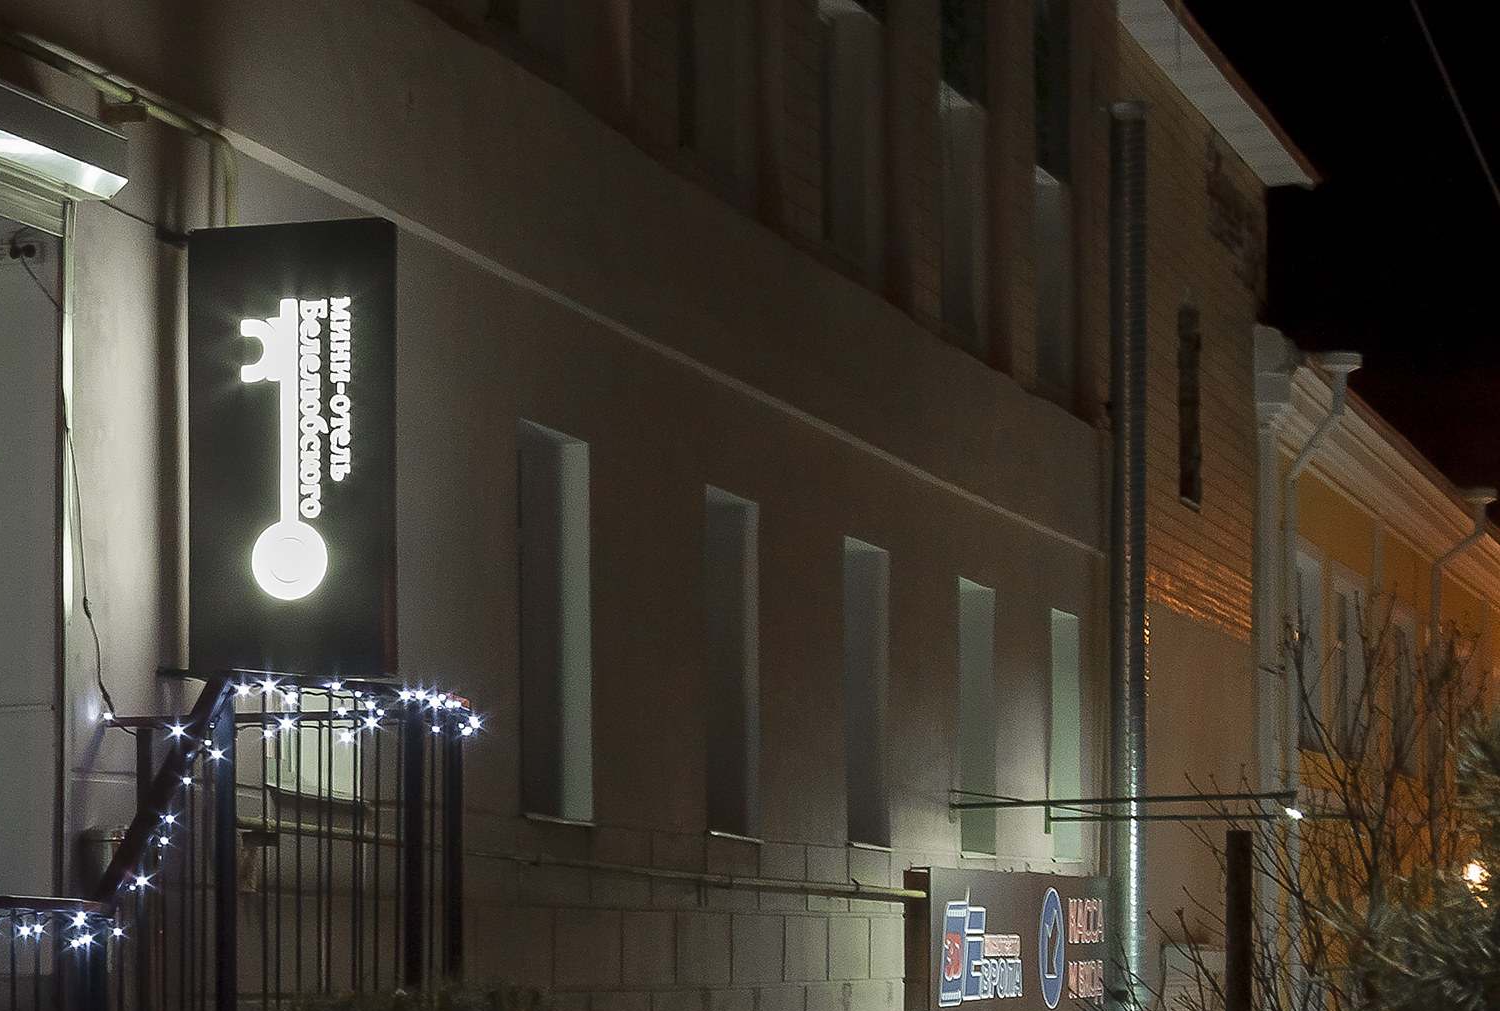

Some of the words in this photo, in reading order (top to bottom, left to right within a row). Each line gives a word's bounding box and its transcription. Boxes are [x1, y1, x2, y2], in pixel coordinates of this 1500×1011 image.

[299, 298, 329, 518] Белелюбского
[329, 296, 351, 481] мини-отель
[1068, 898, 1105, 944] КАССА
